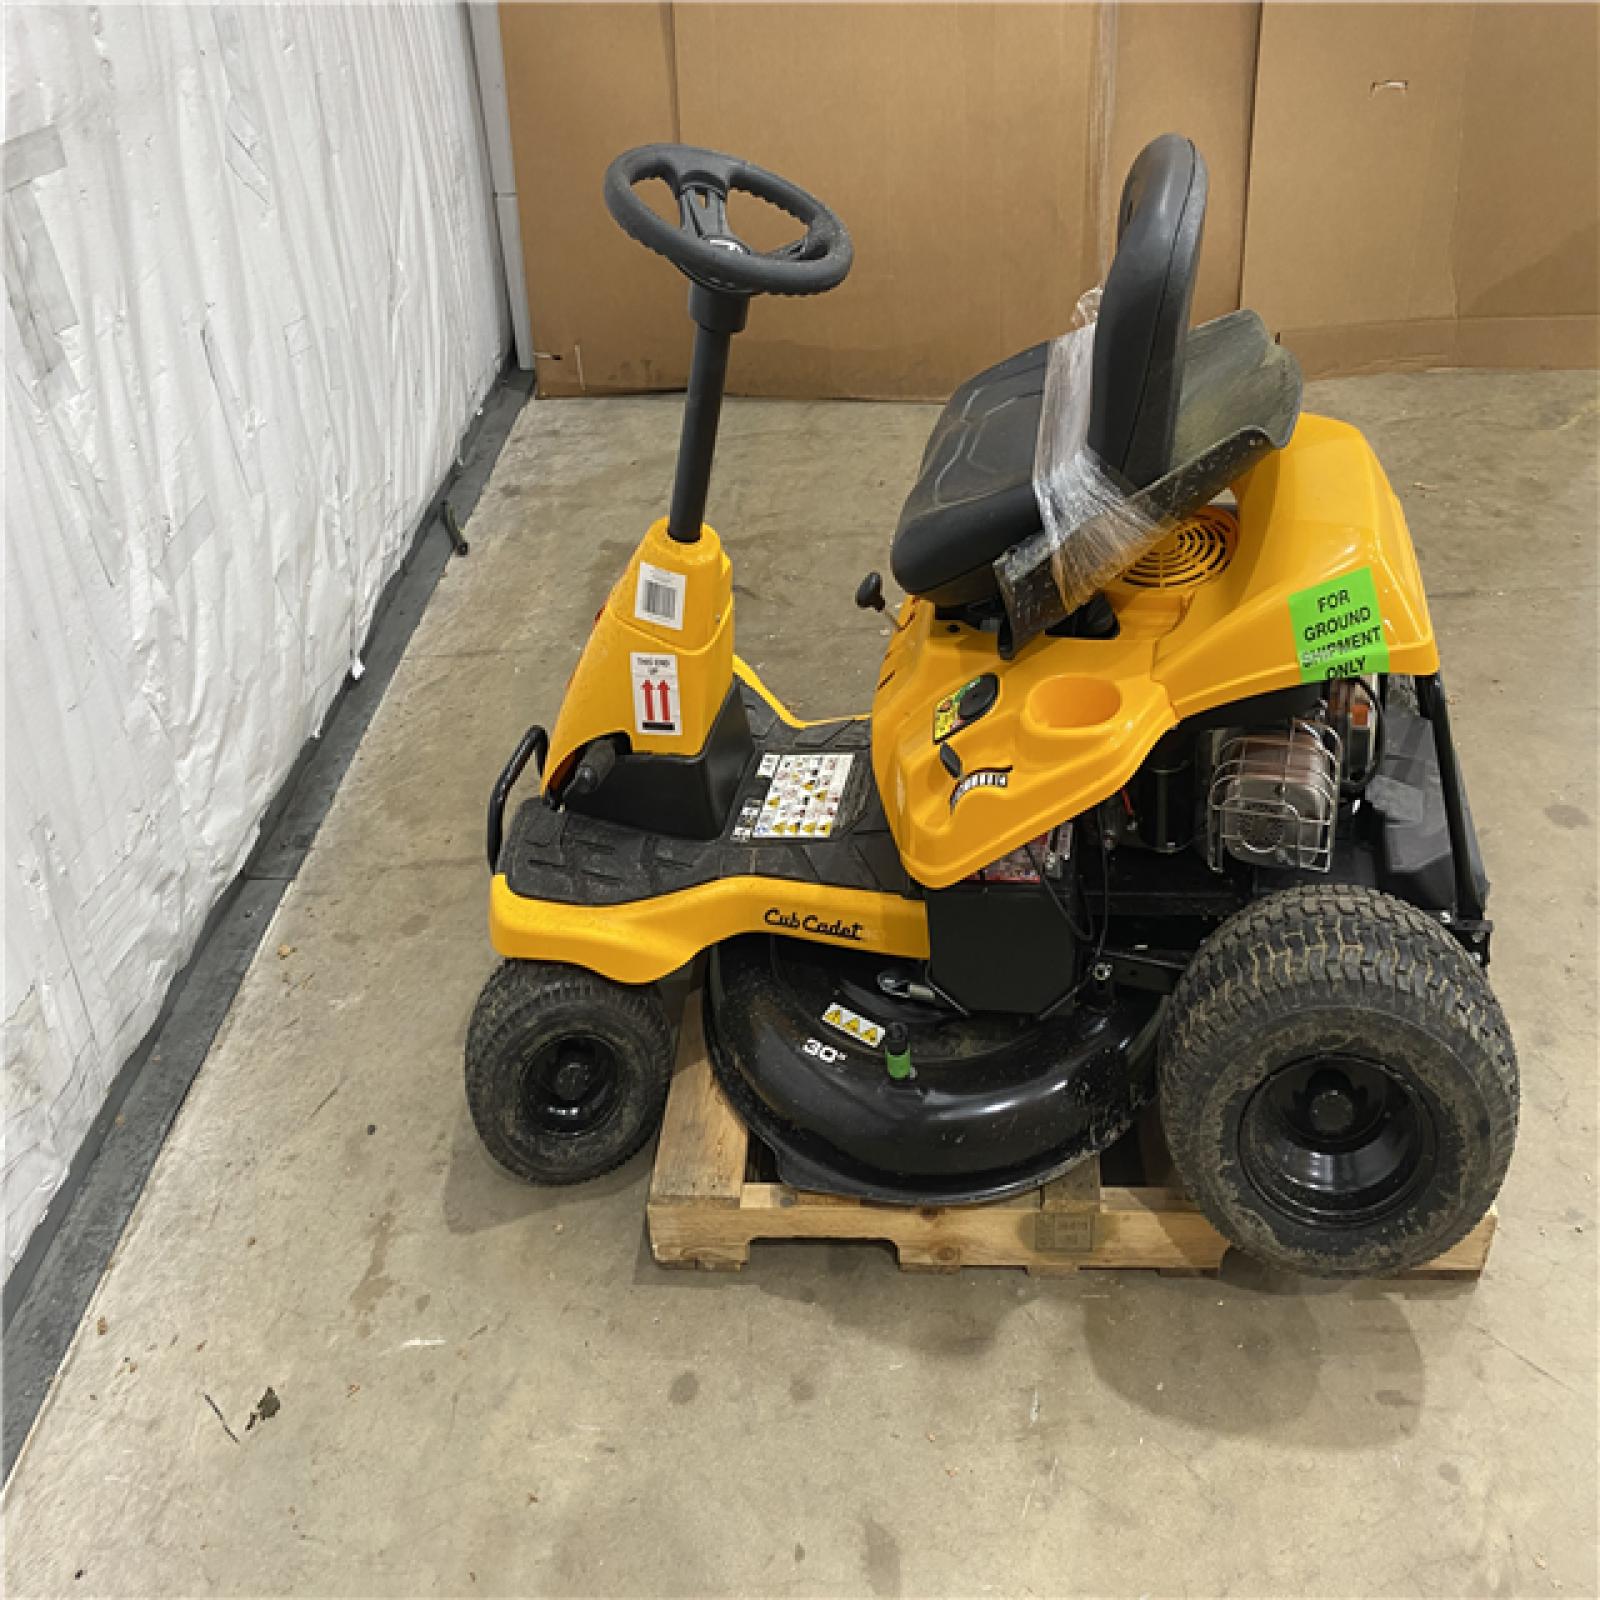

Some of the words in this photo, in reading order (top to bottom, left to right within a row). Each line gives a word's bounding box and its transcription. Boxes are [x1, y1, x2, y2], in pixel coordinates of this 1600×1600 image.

[1317, 589, 1350, 613] FOR
[1304, 606, 1370, 642] GROUND
[764, 907, 800, 929] Cub
[802, 914, 864, 940] Cadet
